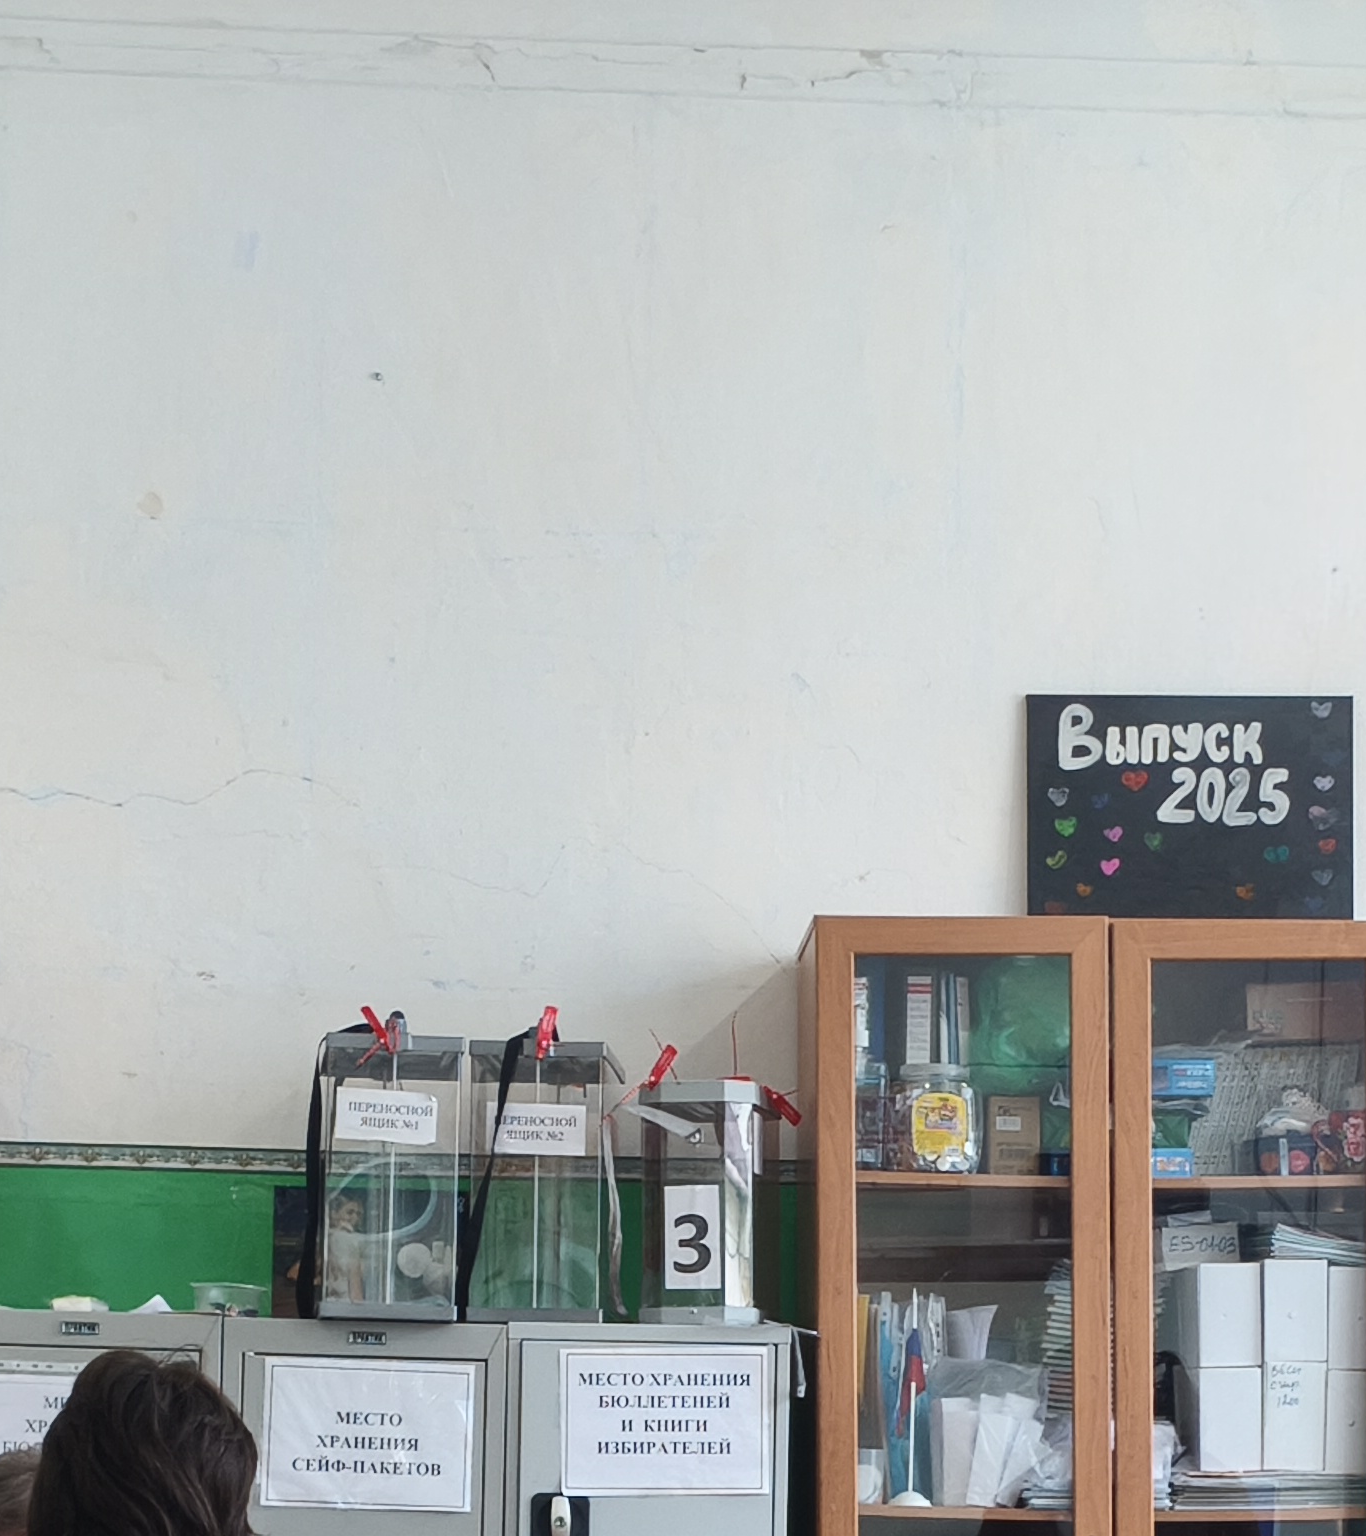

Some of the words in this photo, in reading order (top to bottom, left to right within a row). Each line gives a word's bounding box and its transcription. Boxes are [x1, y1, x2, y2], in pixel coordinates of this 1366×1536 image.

[1057, 703, 1263, 771] Выпуск
[1156, 766, 1291, 827] 2025
[348, 1101, 434, 1117] ПЕРЕНОСНОЙ
[360, 1116, 399, 1130] ЯЩИК
[501, 1114, 578, 1128] ЕРЕНОСНОЙ
[506, 1129, 545, 1141] ЯЩИК
[545, 1130, 565, 1142] №2
[673, 1213, 712, 1274] 3
[578, 1372, 645, 1387] МЕСТО
[648, 1372, 751, 1387] ХРАНЕНИЯ
[598, 1391, 731, 1409] БЮЛЛЕТЕНЕЙ
[335, 1410, 403, 1427] МЕСТО
[621, 1419, 633, 1432] И
[643, 1419, 708, 1432] КНИГИ
[315, 1434, 419, 1452] ХРАНЕНИЯ
[597, 1437, 731, 1455] ИЗБИРАТЕЛЕЙ
[291, 1455, 442, 1477] СЕЙФ-ПАКЕТОВ
